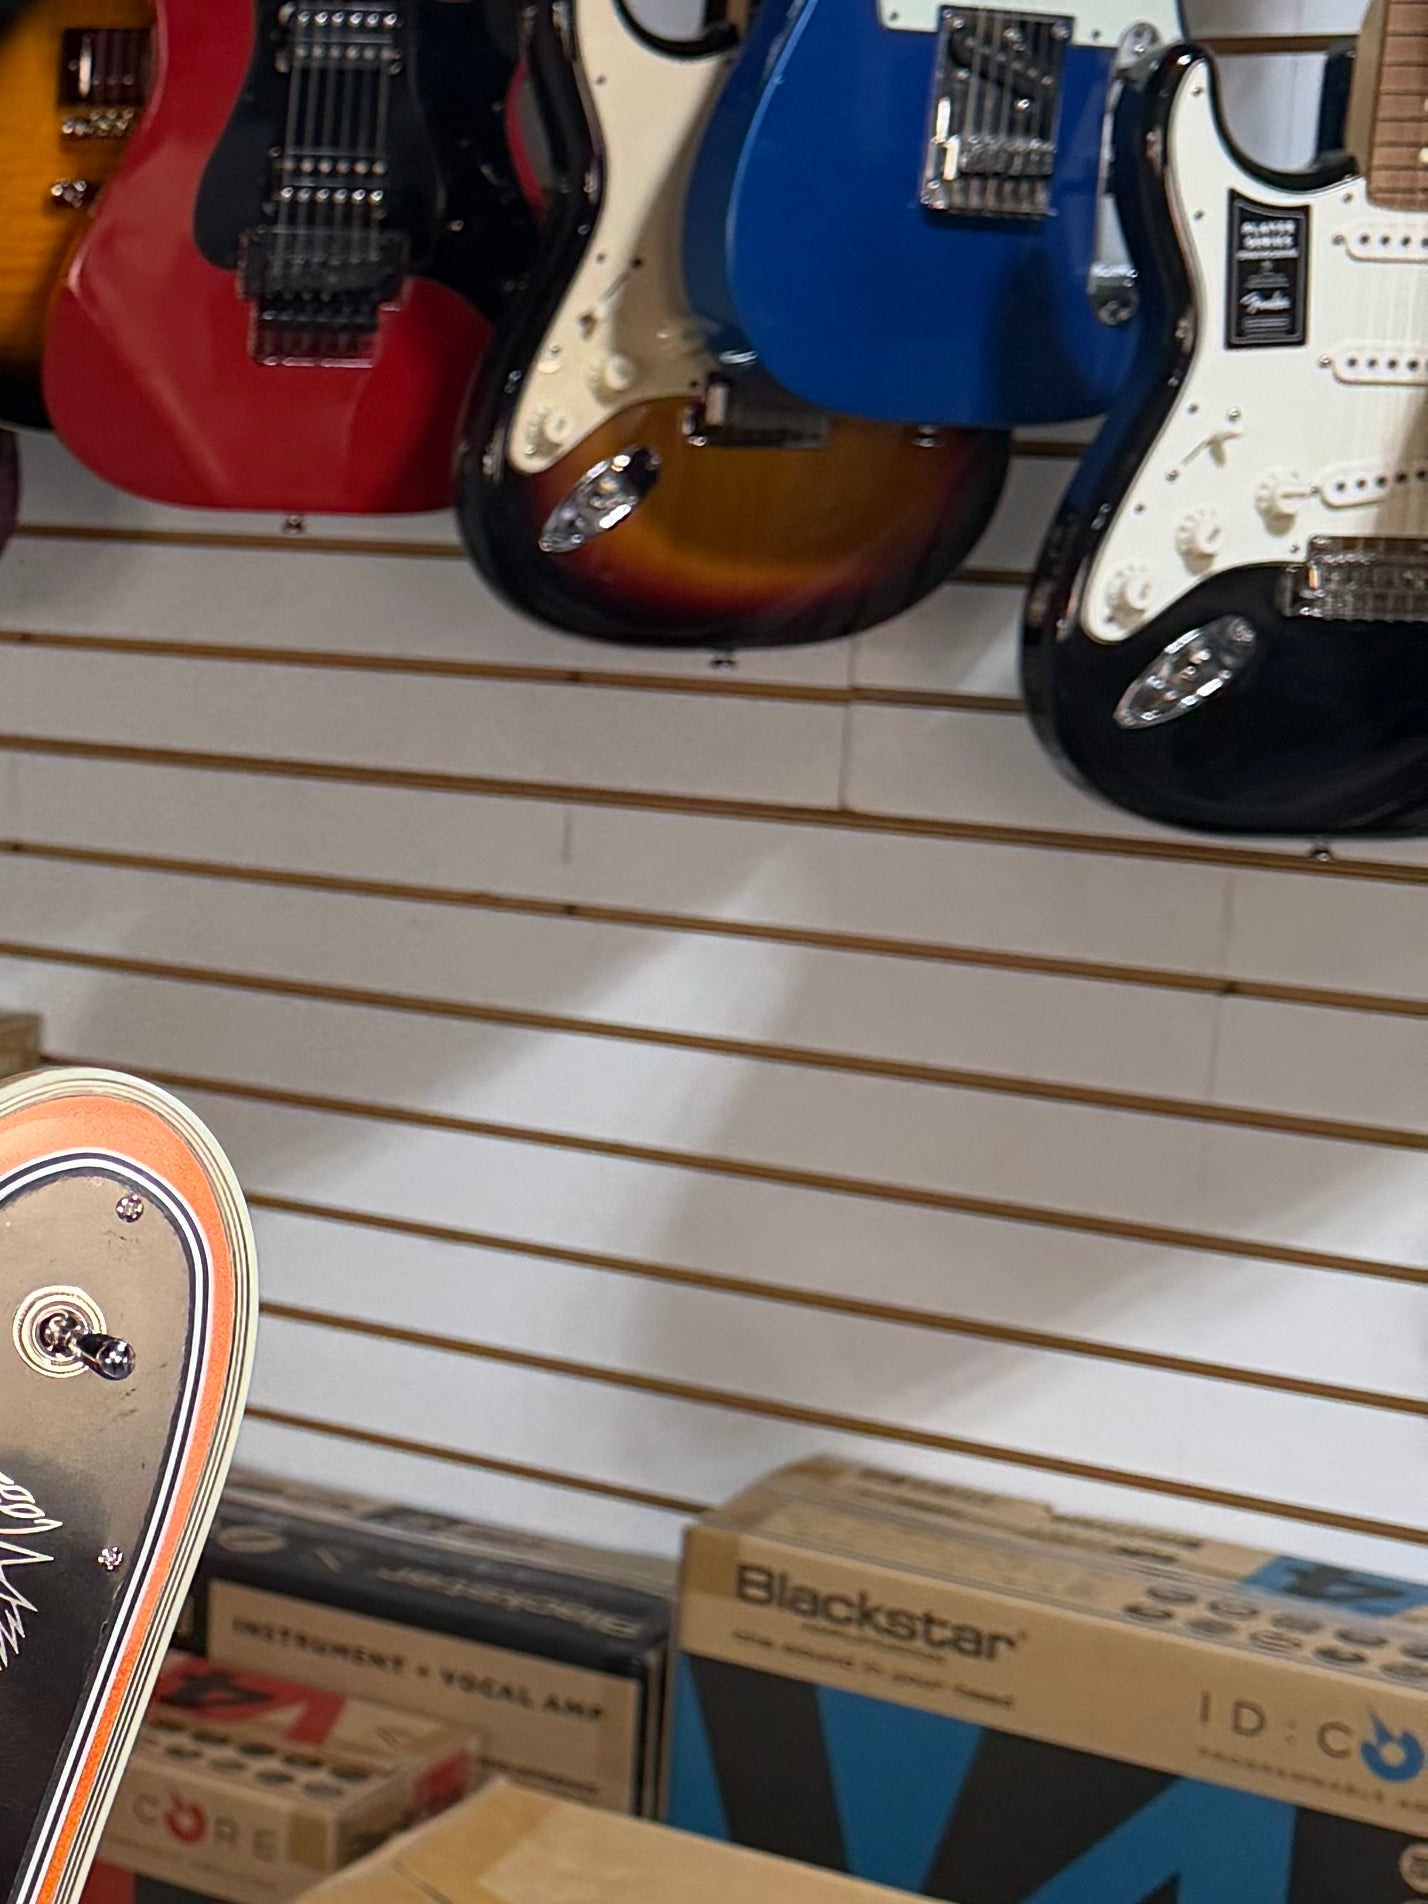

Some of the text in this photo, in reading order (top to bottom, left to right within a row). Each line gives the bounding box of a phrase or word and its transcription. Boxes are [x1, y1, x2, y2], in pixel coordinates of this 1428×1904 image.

[736, 1563, 1017, 1660] Blackstar
[232, 1616, 407, 1673] INSTRUMENT
[441, 1669, 532, 1710] VOCAL
[542, 1695, 607, 1721] AMP
